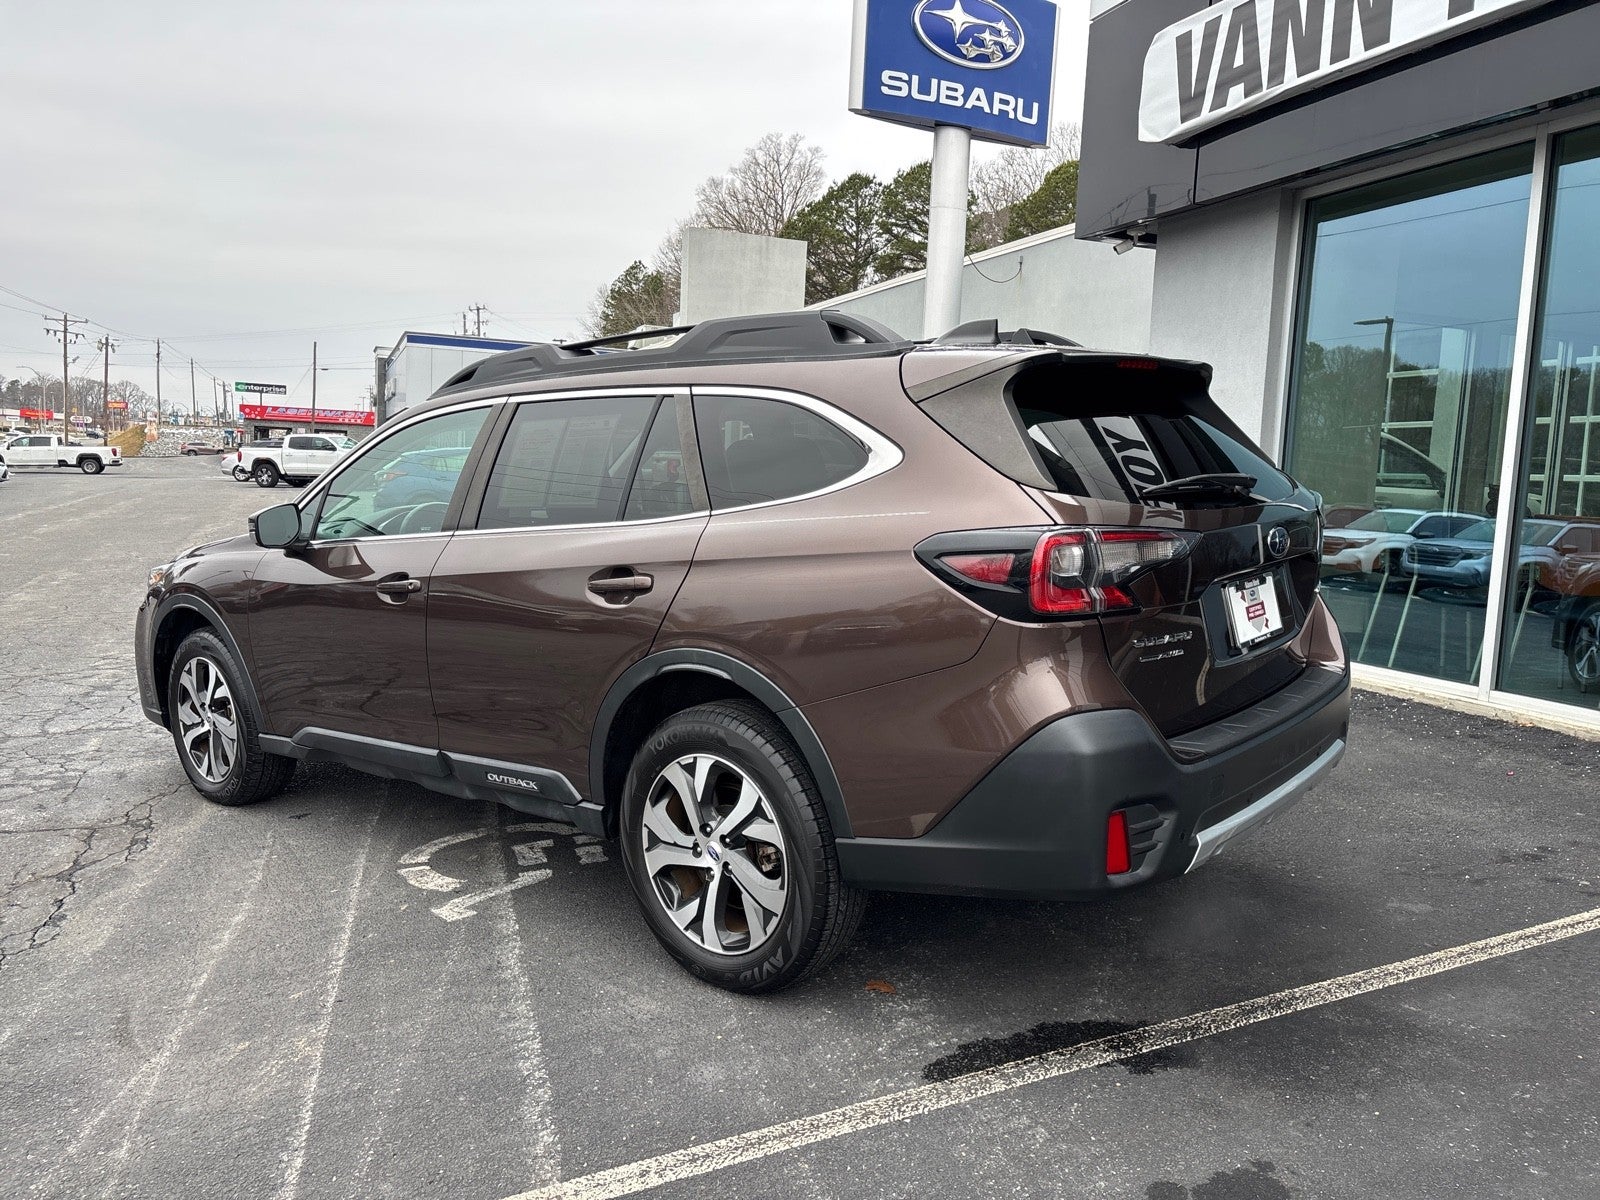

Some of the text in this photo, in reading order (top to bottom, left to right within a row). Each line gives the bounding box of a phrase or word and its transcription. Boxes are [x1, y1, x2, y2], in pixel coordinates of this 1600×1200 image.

[1175, 0, 1393, 124] VANN
[880, 69, 1039, 125] SUBARU
[236, 384, 286, 393] enterprise
[487, 773, 538, 790] OUTBACK
